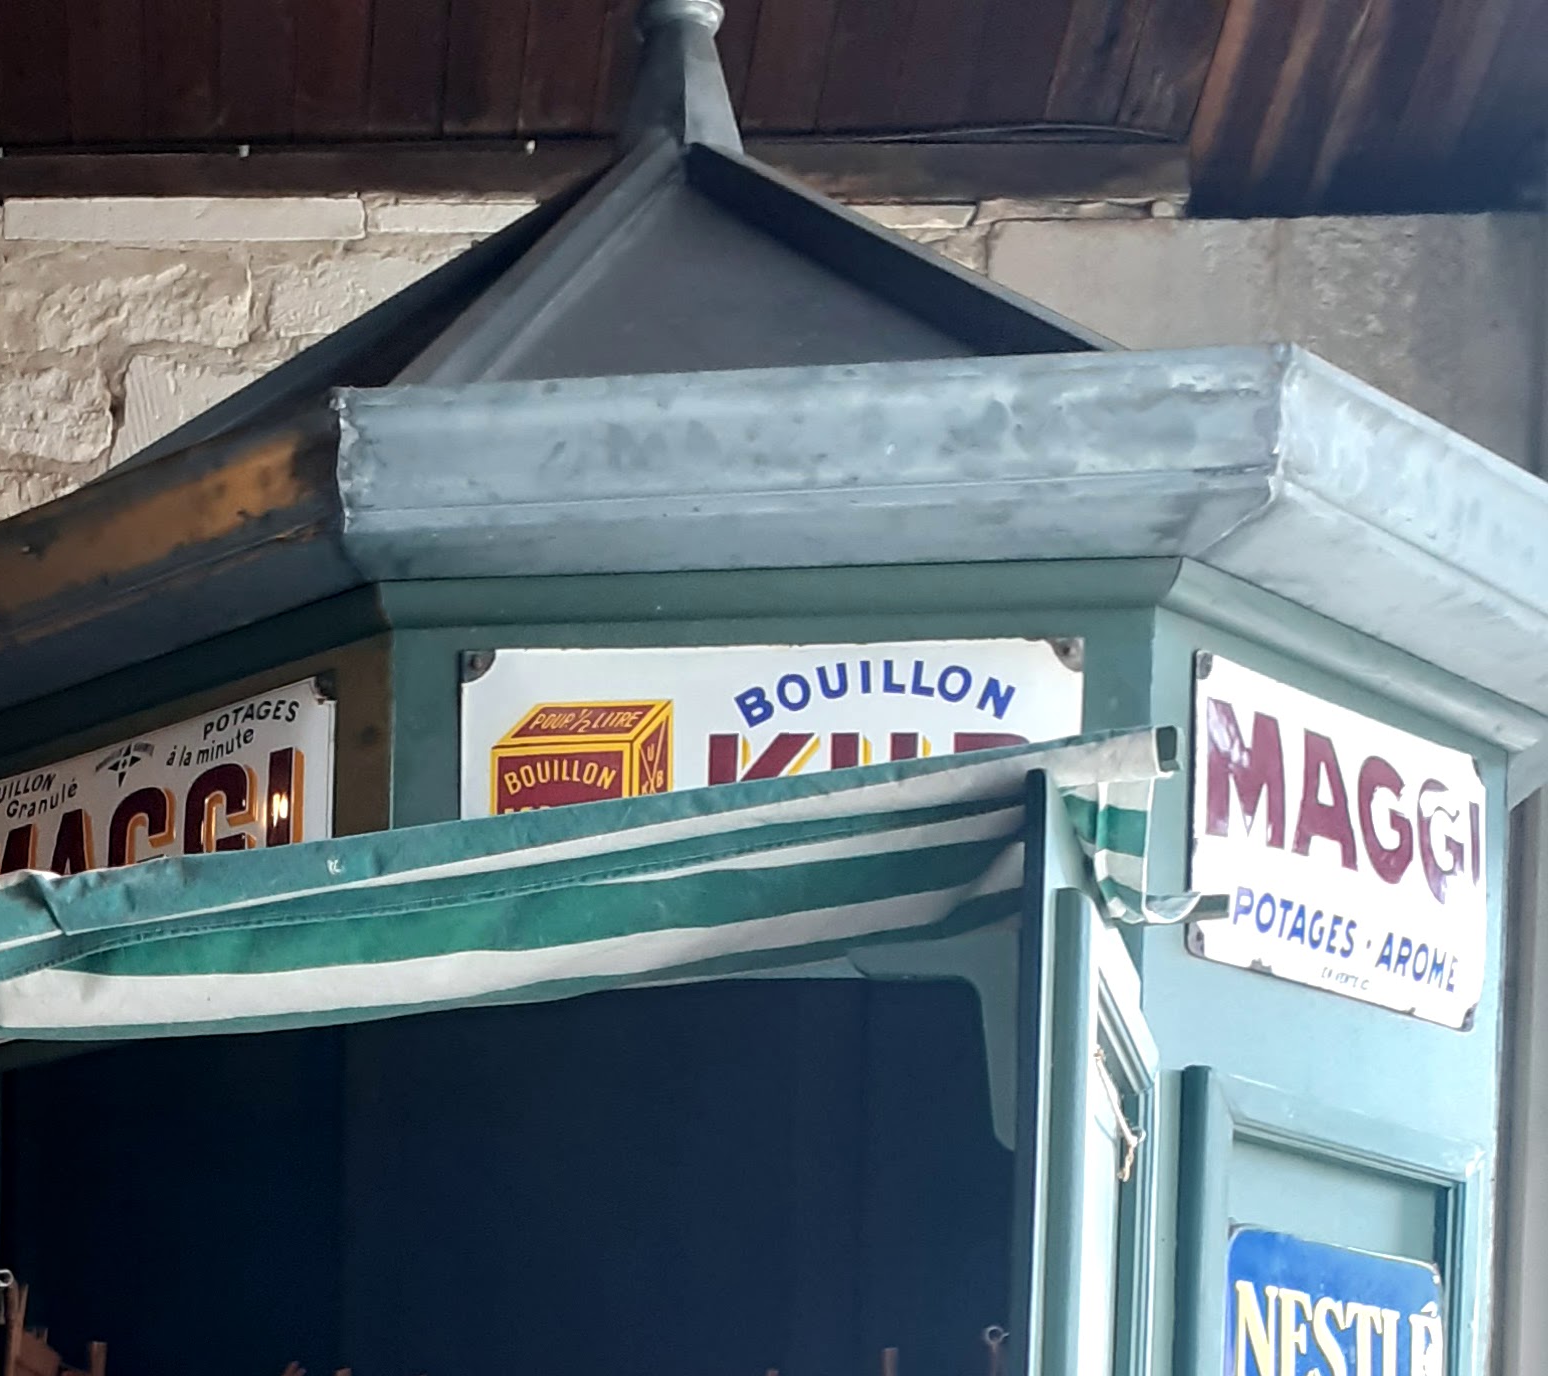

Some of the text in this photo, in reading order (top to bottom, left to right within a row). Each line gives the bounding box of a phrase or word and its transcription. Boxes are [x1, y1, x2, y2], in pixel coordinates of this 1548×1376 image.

[733, 658, 1016, 729] BOUILLON
[203, 699, 300, 741] POTAGES
[592, 711, 642, 730] LITRE
[178, 746, 191, 767] la
[196, 727, 256, 765] minute
[503, 758, 616, 796] BOUILLON
[5, 779, 79, 819] Granulé
[1205, 696, 1480, 905] MAGGI
[1232, 886, 1357, 959] POTAGES
